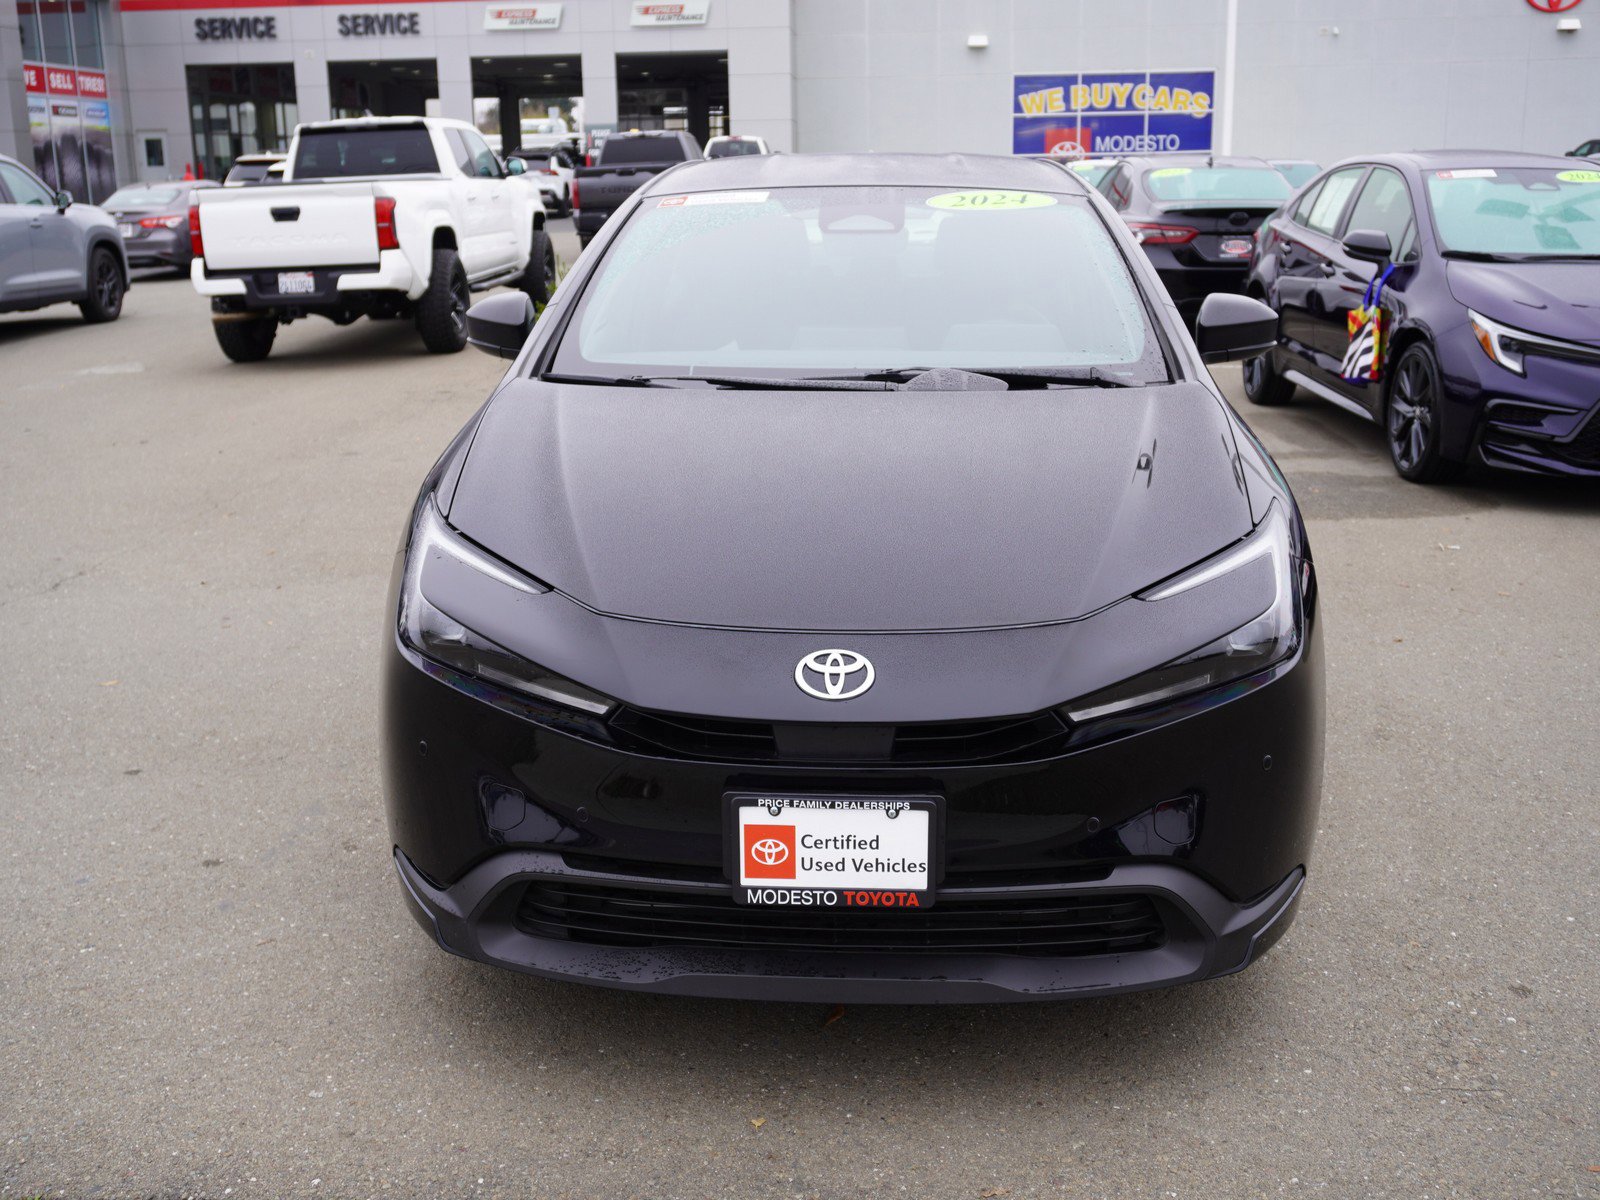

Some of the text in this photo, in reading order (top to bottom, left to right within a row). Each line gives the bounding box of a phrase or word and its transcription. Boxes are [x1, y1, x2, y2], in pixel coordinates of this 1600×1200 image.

[501, 9, 535, 18] EXPRESS
[648, 5, 682, 14] EXPRESS
[655, 13, 704, 22] MAINTENANCE
[195, 16, 277, 40] SERVICE
[338, 12, 420, 37] SERVICE
[509, 18, 556, 26] MAINTENANCE
[49, 71, 73, 89] SELL
[1018, 82, 1211, 118] WE BUY CARS
[1095, 134, 1180, 153] MODESTO
[951, 193, 1028, 207] 2024
[232, 233, 347, 248] TACOMA
[757, 798, 911, 811] PRICE FAMILY DEALERSHIPS
[801, 834, 879, 850] Certified
[801, 857, 926, 873] Used Vehicles
[747, 889, 920, 907] MODESTO TOYOTA
